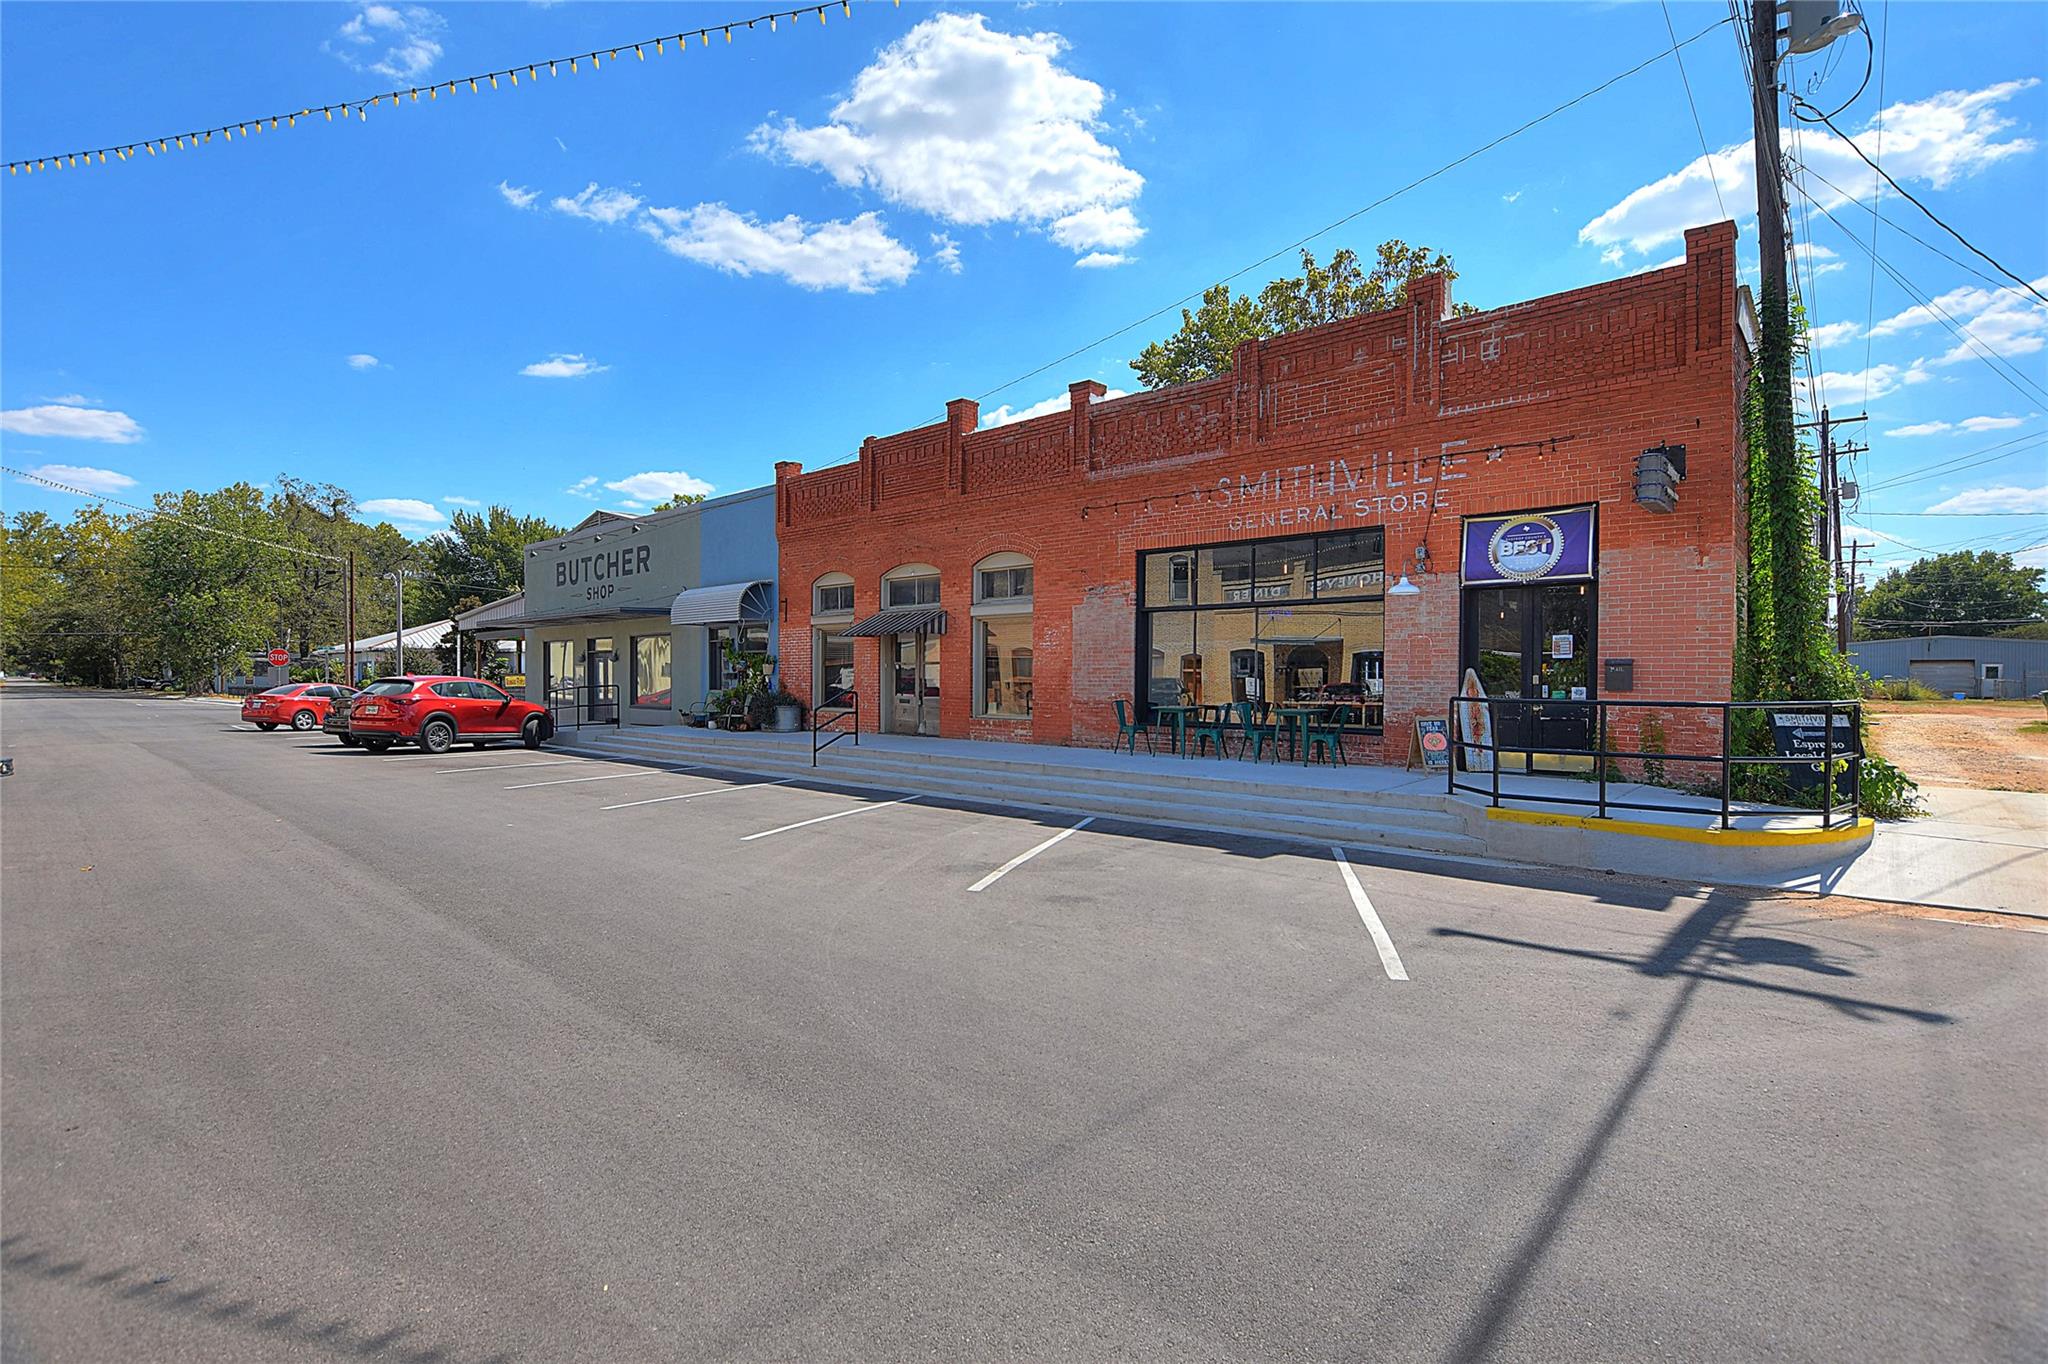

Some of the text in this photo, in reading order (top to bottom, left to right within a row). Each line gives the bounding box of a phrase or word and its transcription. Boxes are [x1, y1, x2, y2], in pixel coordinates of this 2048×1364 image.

[1215, 440, 1468, 508] SMITHVILLE
[1229, 488, 1450, 531] GENERAL STORE
[1501, 538, 1552, 556] BEST
[556, 545, 651, 587] BUTCHER
[586, 584, 615, 600] SHOP
[1793, 739, 1845, 750] Espreso
